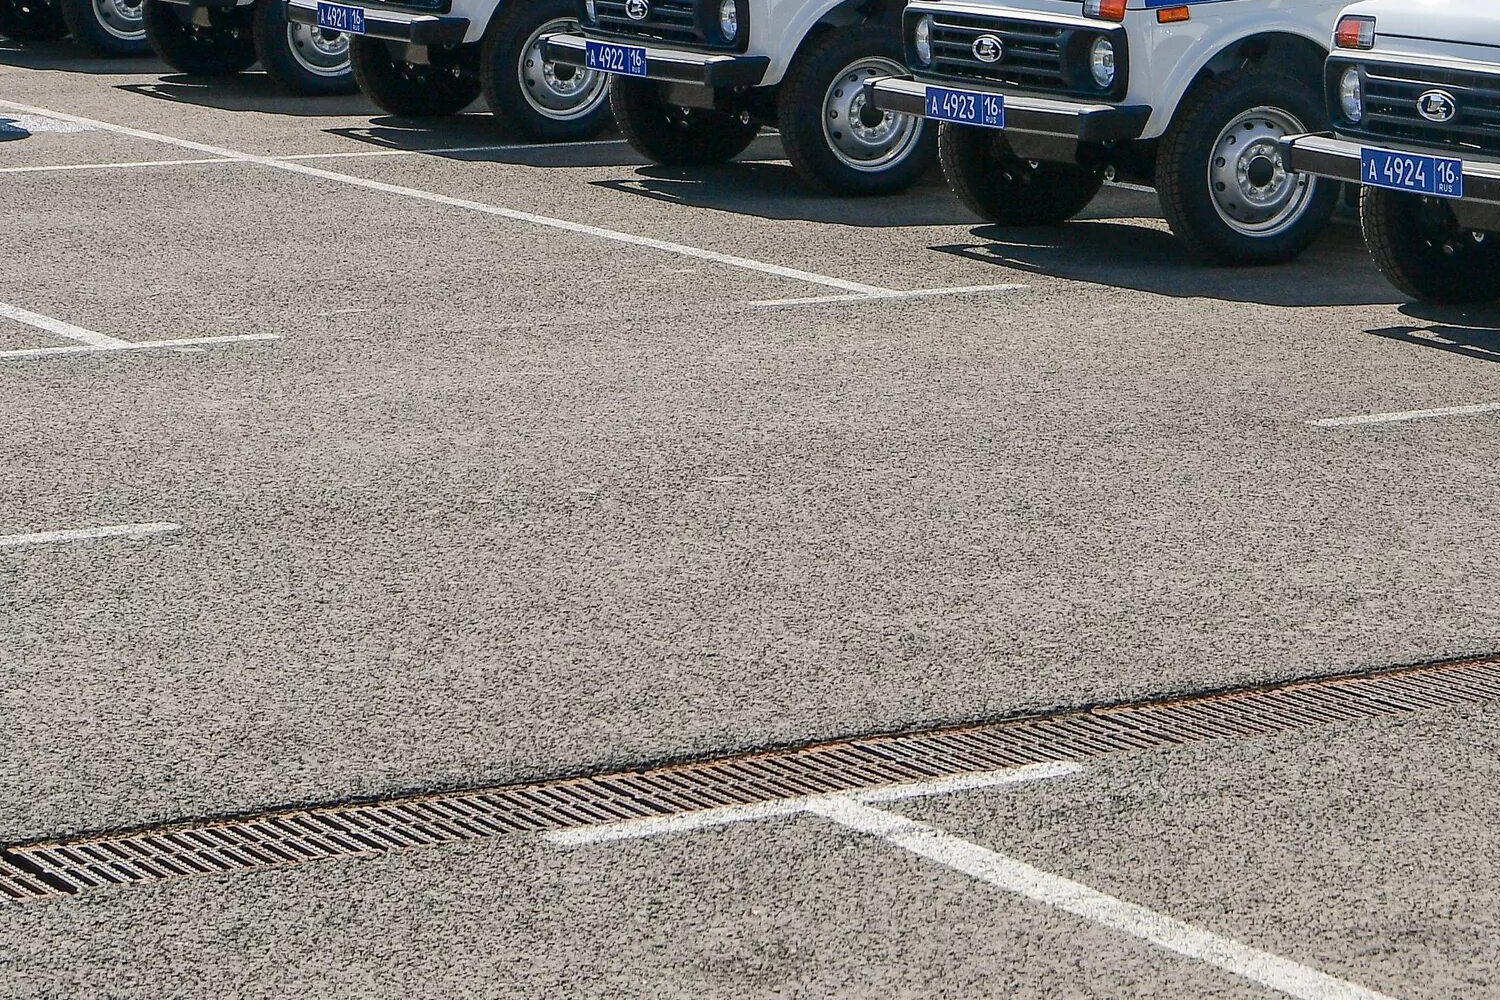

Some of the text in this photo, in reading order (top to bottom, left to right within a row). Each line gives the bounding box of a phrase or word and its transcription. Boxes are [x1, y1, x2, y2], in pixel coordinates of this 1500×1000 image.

[328, 6, 347, 28] 4921
[352, 10, 360, 24] 16
[590, 46, 641, 70] А 4922 16
[931, 93, 998, 119] А 4923 16
[1368, 156, 1454, 187] А 4924 16
[1438, 184, 1453, 192] RUS
